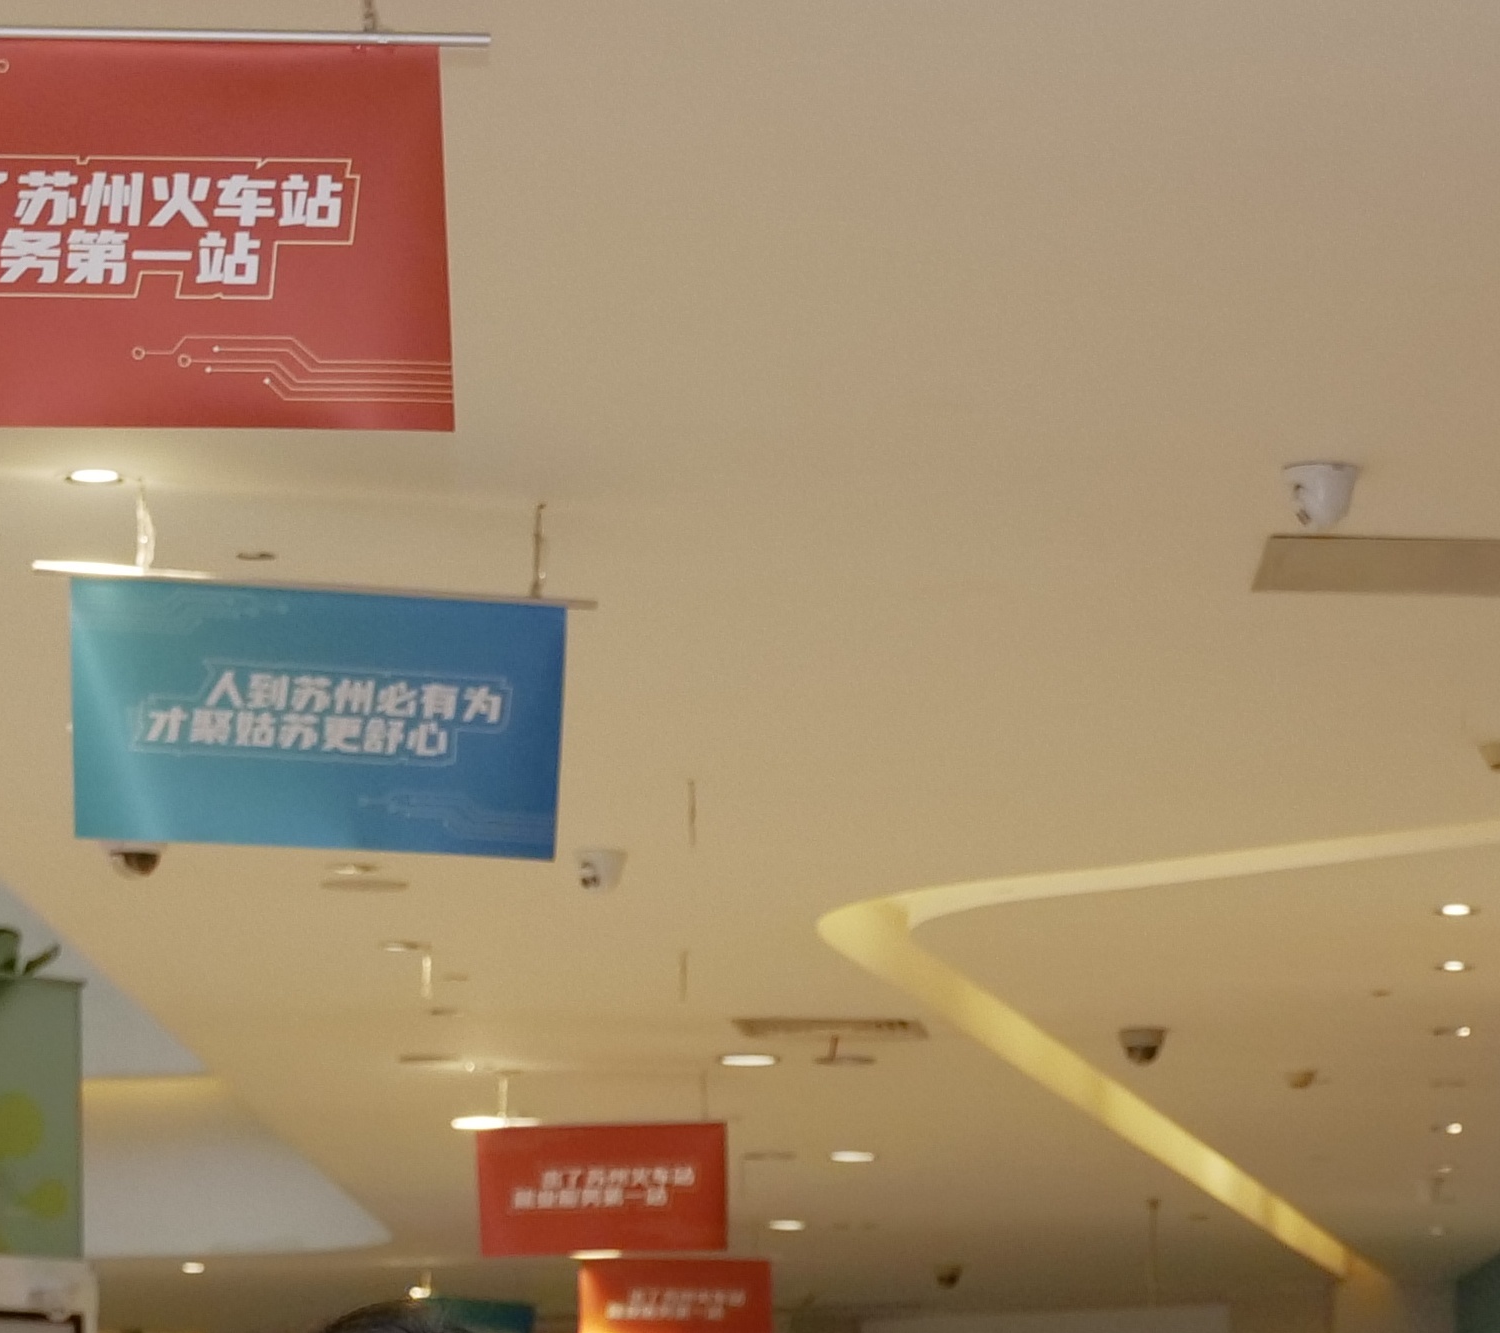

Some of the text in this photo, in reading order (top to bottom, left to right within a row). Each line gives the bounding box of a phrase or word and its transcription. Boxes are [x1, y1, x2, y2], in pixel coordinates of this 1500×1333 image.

[205, 670, 502, 724] 人到苏州必有为
[146, 704, 449, 758] 才聚姑苏更舒心
